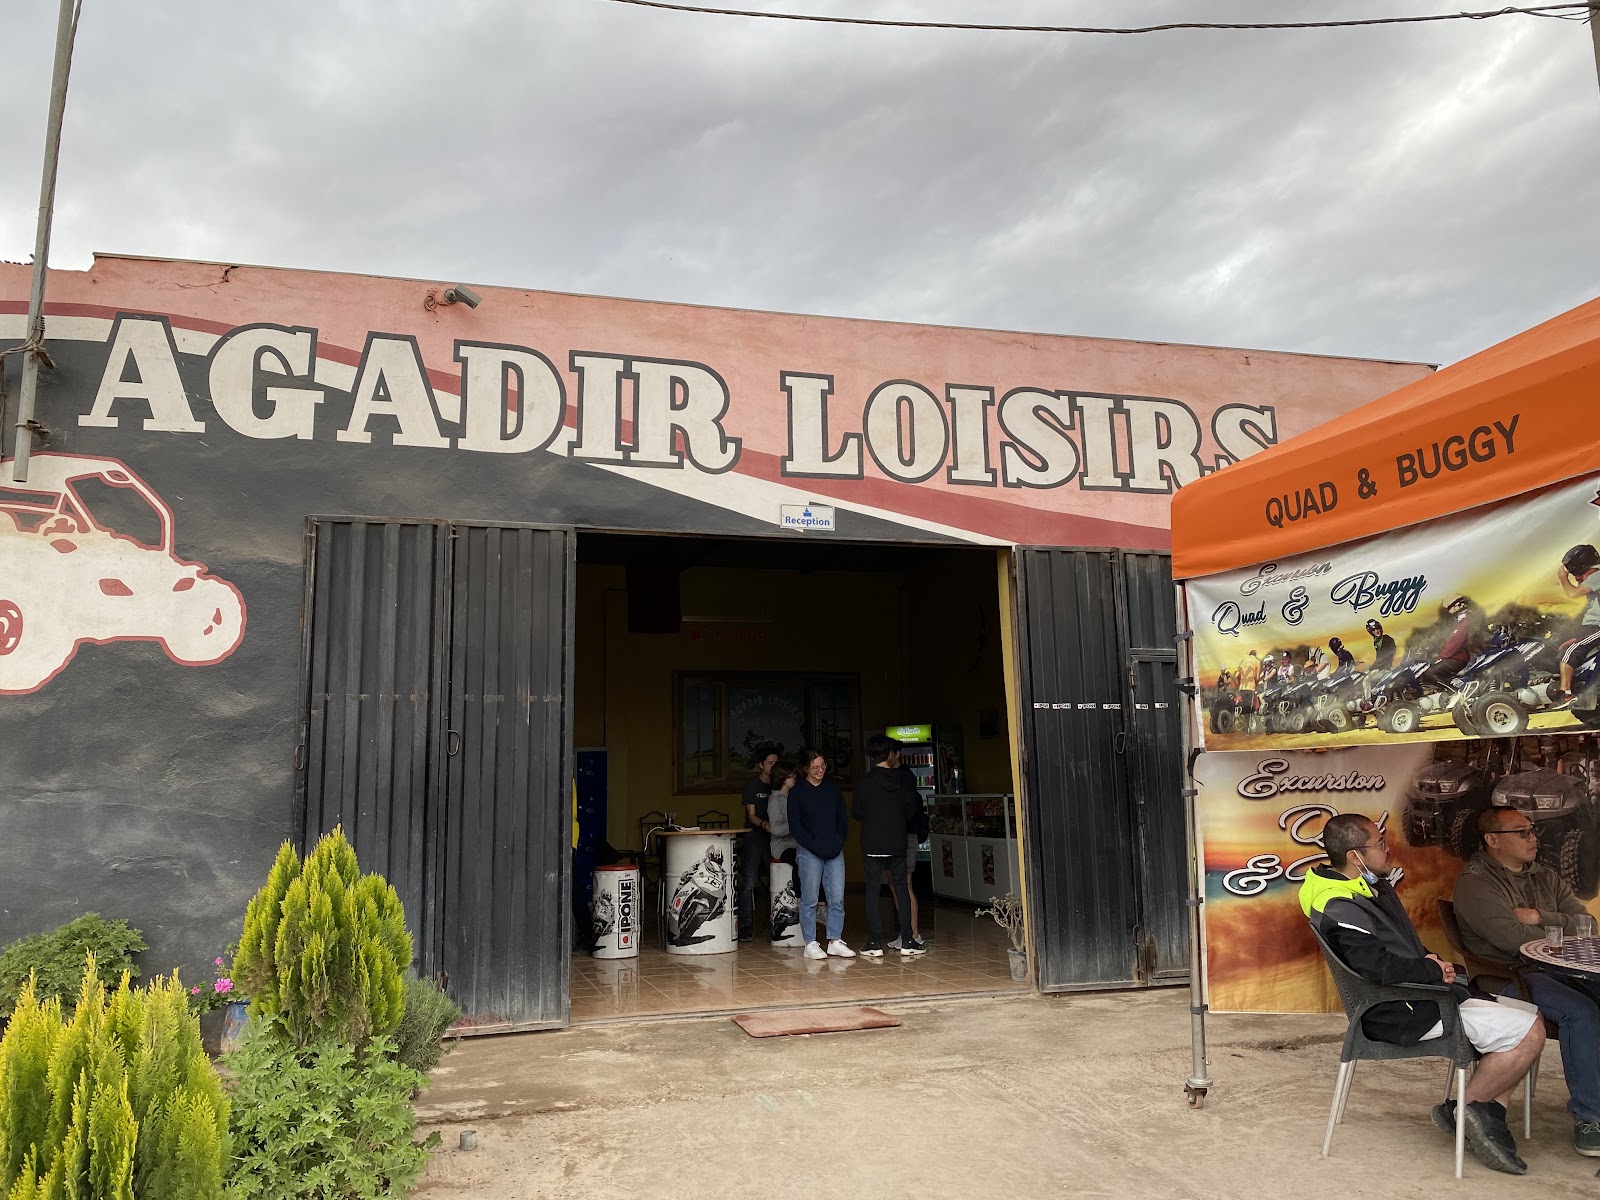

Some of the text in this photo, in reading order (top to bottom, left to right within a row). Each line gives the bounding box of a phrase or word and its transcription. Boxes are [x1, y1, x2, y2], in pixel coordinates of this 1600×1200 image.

[77, 312, 742, 474] AGADIR
[1265, 415, 1521, 528] QUAD & BUGGY
[785, 516, 830, 526] Reception
[1239, 562, 1332, 596] Excursion
[1211, 570, 1427, 637] Quad & Buggy
[1237, 757, 1385, 798] Excursion
[1222, 854, 1284, 895] &
[620, 882, 632, 933] IPONE
